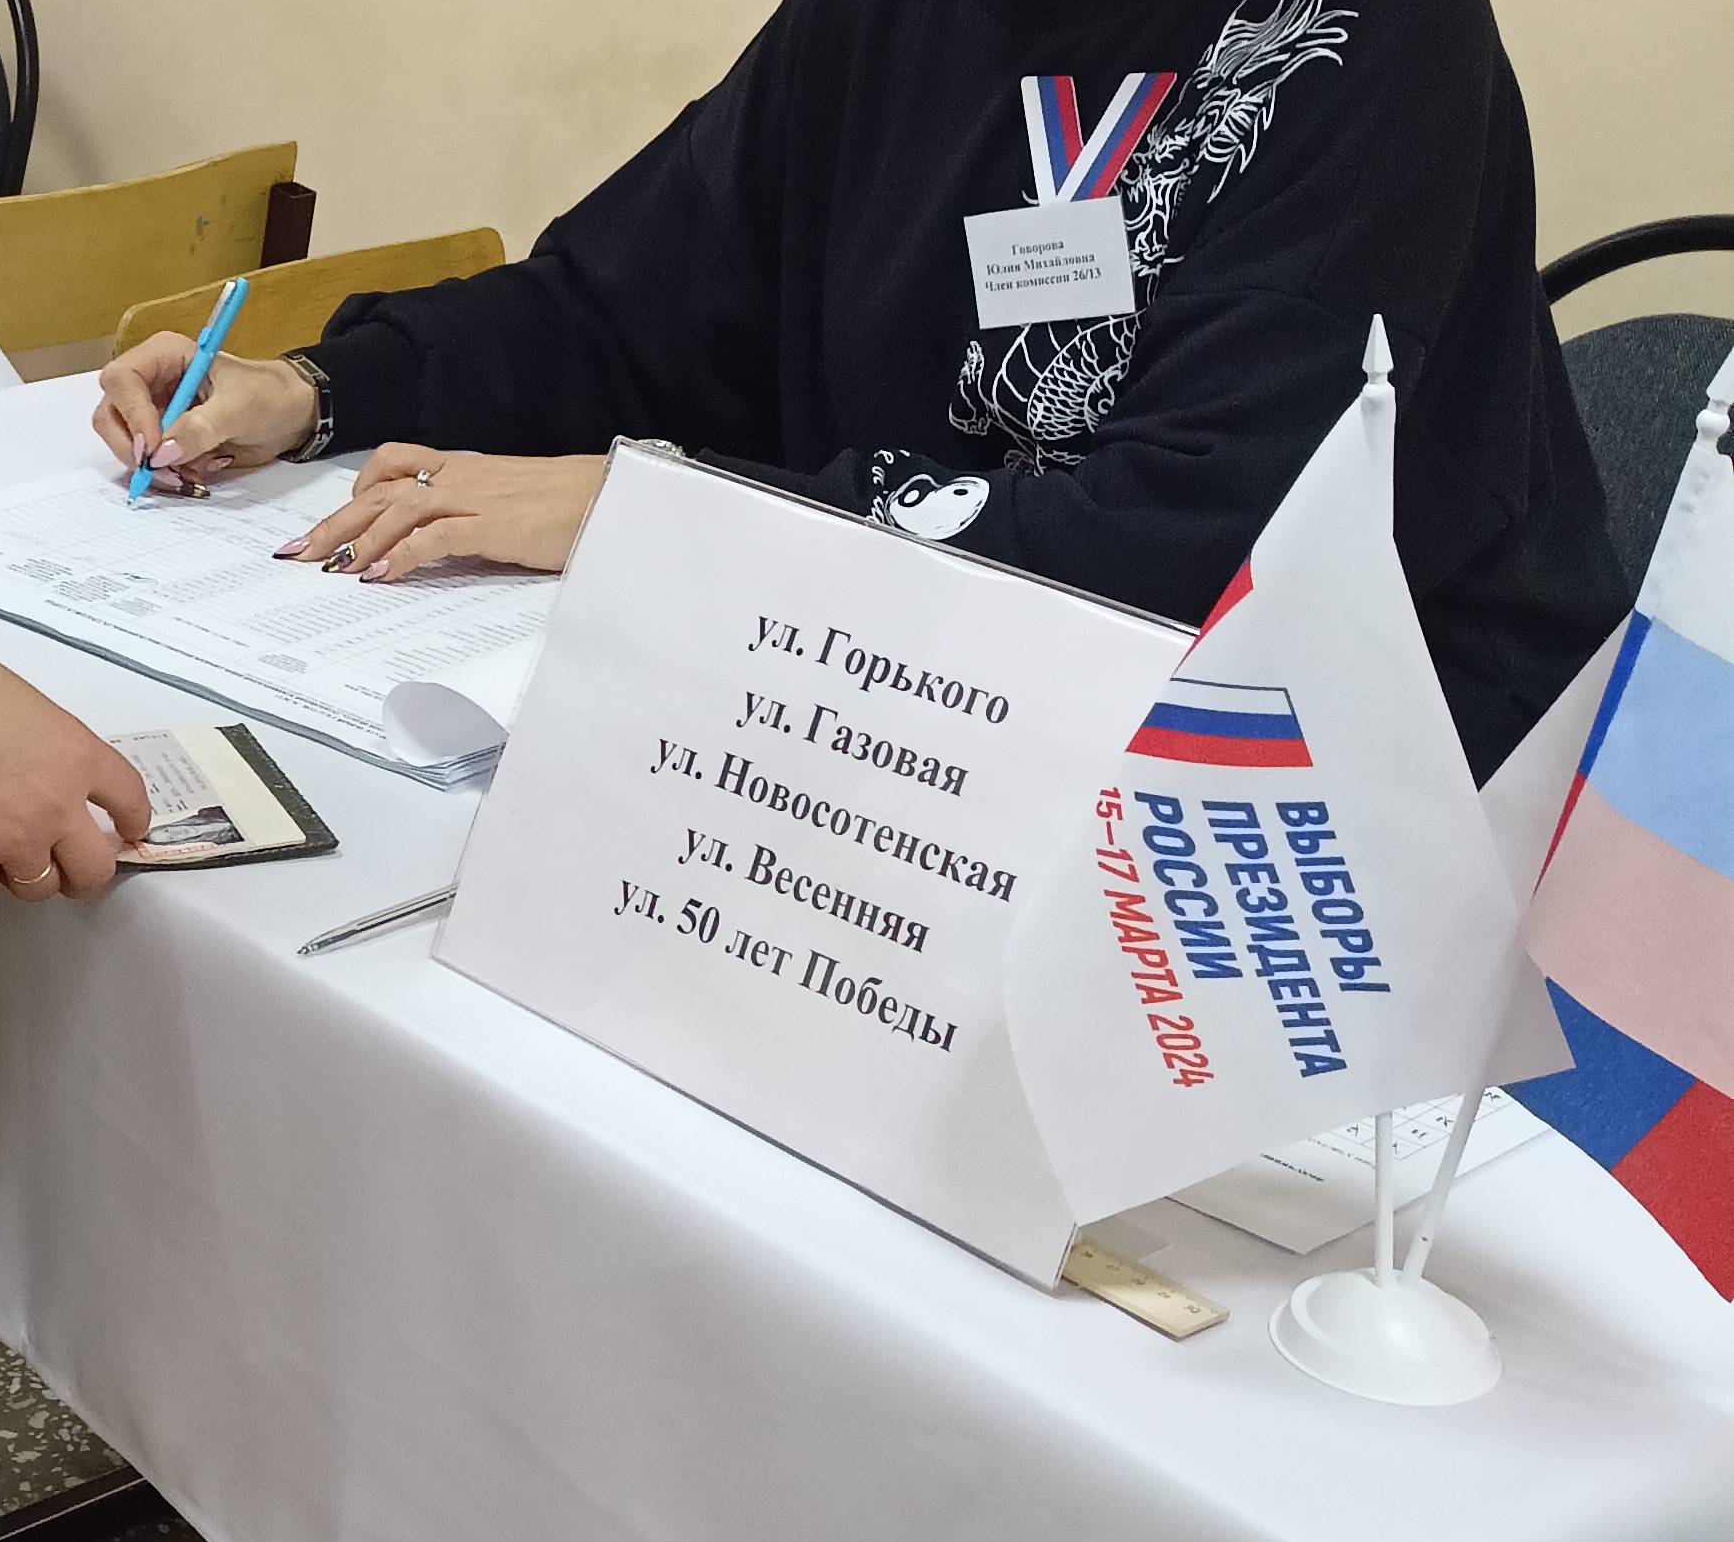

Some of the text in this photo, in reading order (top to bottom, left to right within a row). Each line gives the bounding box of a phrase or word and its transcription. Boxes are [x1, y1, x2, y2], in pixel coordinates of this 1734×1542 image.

[985, 280, 1014, 292] Член
[1016, 274, 1070, 290] комиссии
[986, 253, 1096, 276] Юлия Михайловна
[1011, 240, 1065, 256] Говорова
[747, 615, 1010, 724] ул. Горького
[736, 691, 970, 797] ул. Газовая
[650, 737, 1018, 903] ул. Новосотенская
[677, 828, 931, 954] ул. Весенняя
[1133, 790, 1244, 979] РОССИИ
[614, 879, 959, 1053] ул. 50 лет Победы
[1201, 800, 1348, 1078] ПРЕЗИДЕНТА
[1275, 801, 1391, 993] ВЫБОРЫ
[1103, 889, 1184, 1005] МАРТА
[1146, 1013, 1215, 1088] 2024
